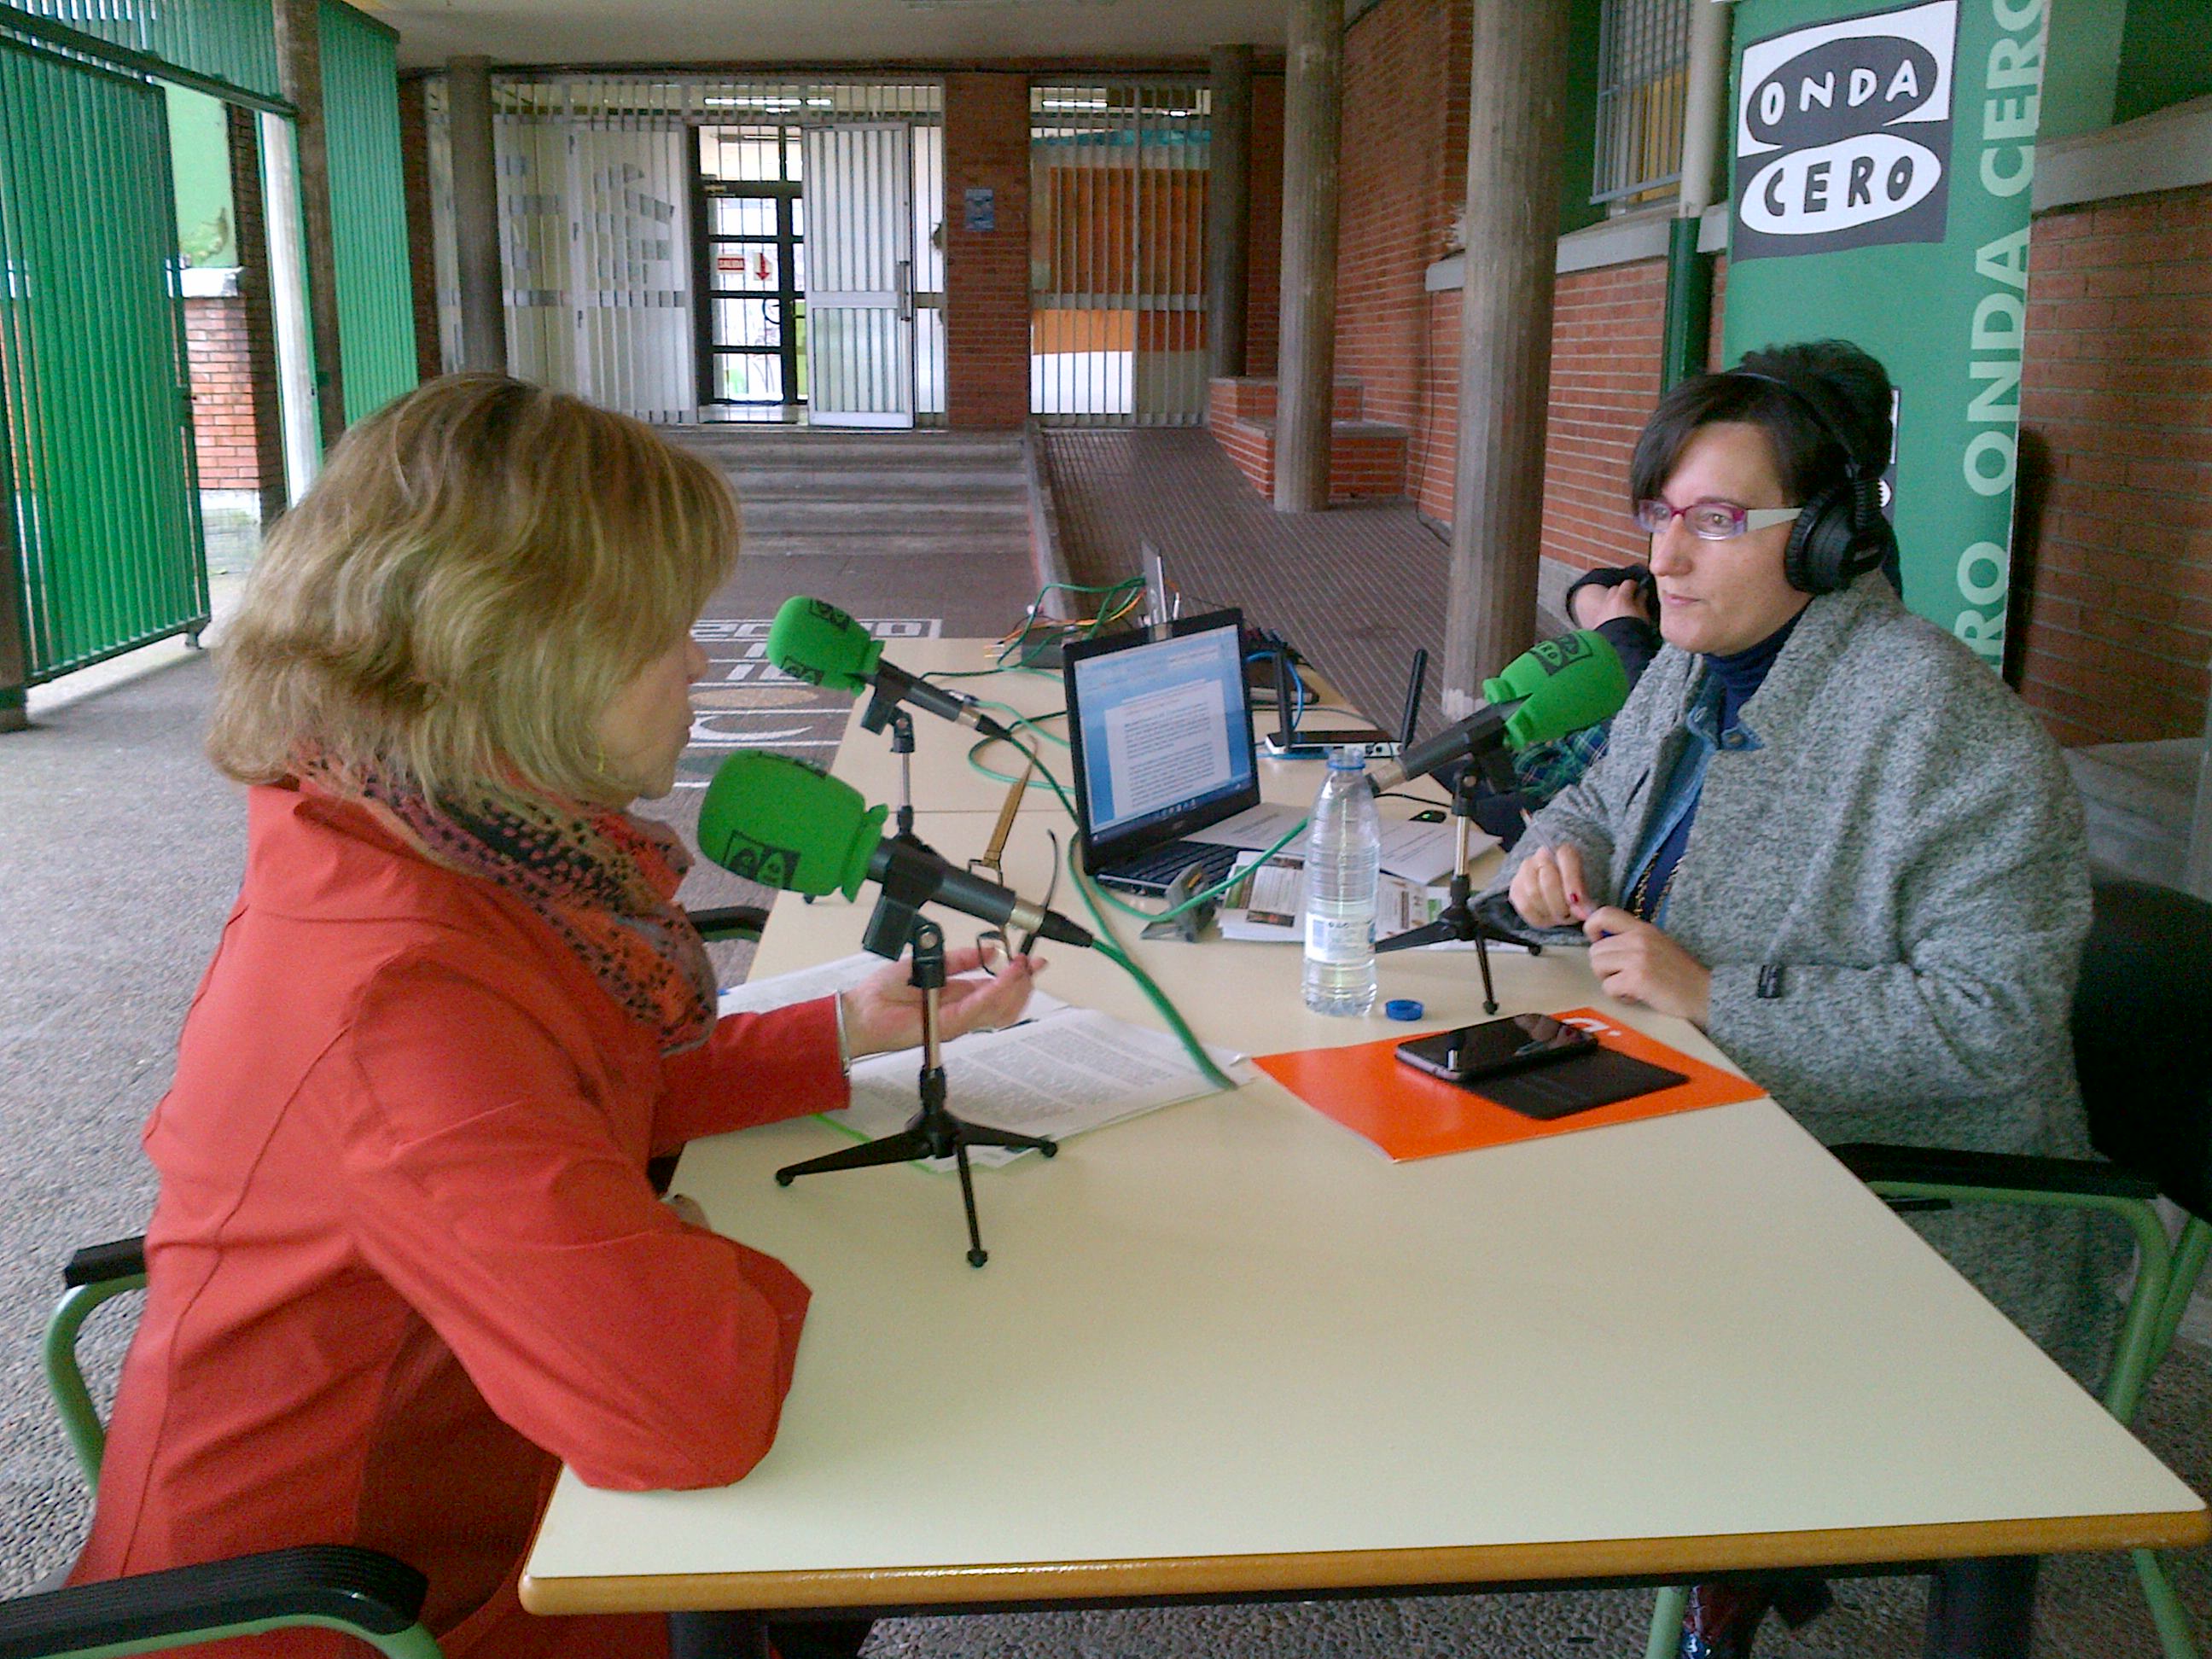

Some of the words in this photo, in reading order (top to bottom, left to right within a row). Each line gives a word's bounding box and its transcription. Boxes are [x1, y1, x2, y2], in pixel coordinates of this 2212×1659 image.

[1760, 59, 1918, 125] ONDA
[1764, 155, 1913, 217] CERO
[1964, 227, 2030, 496] ONDA
